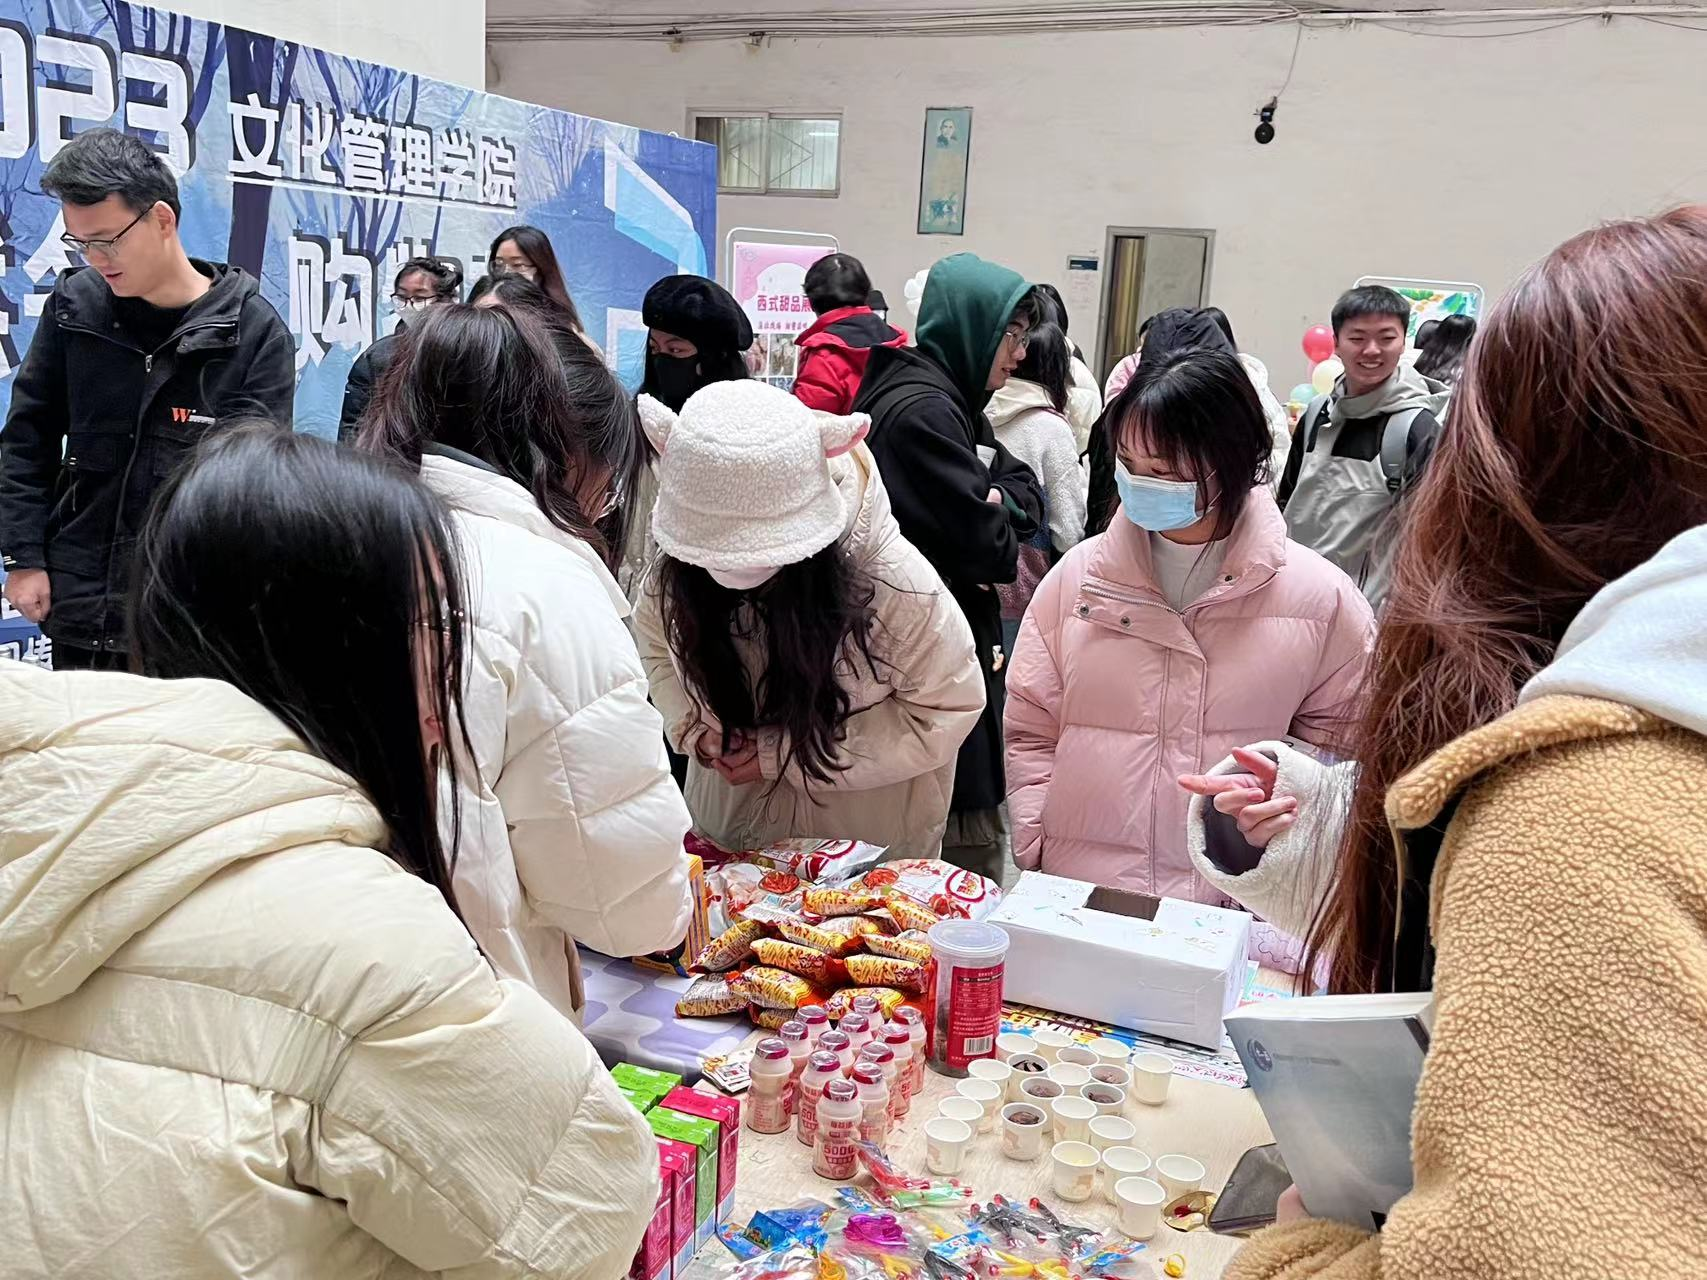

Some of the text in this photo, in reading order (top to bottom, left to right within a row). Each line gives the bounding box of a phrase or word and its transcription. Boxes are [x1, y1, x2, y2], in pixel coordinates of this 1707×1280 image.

[226, 92, 516, 206] 文化管理学院
